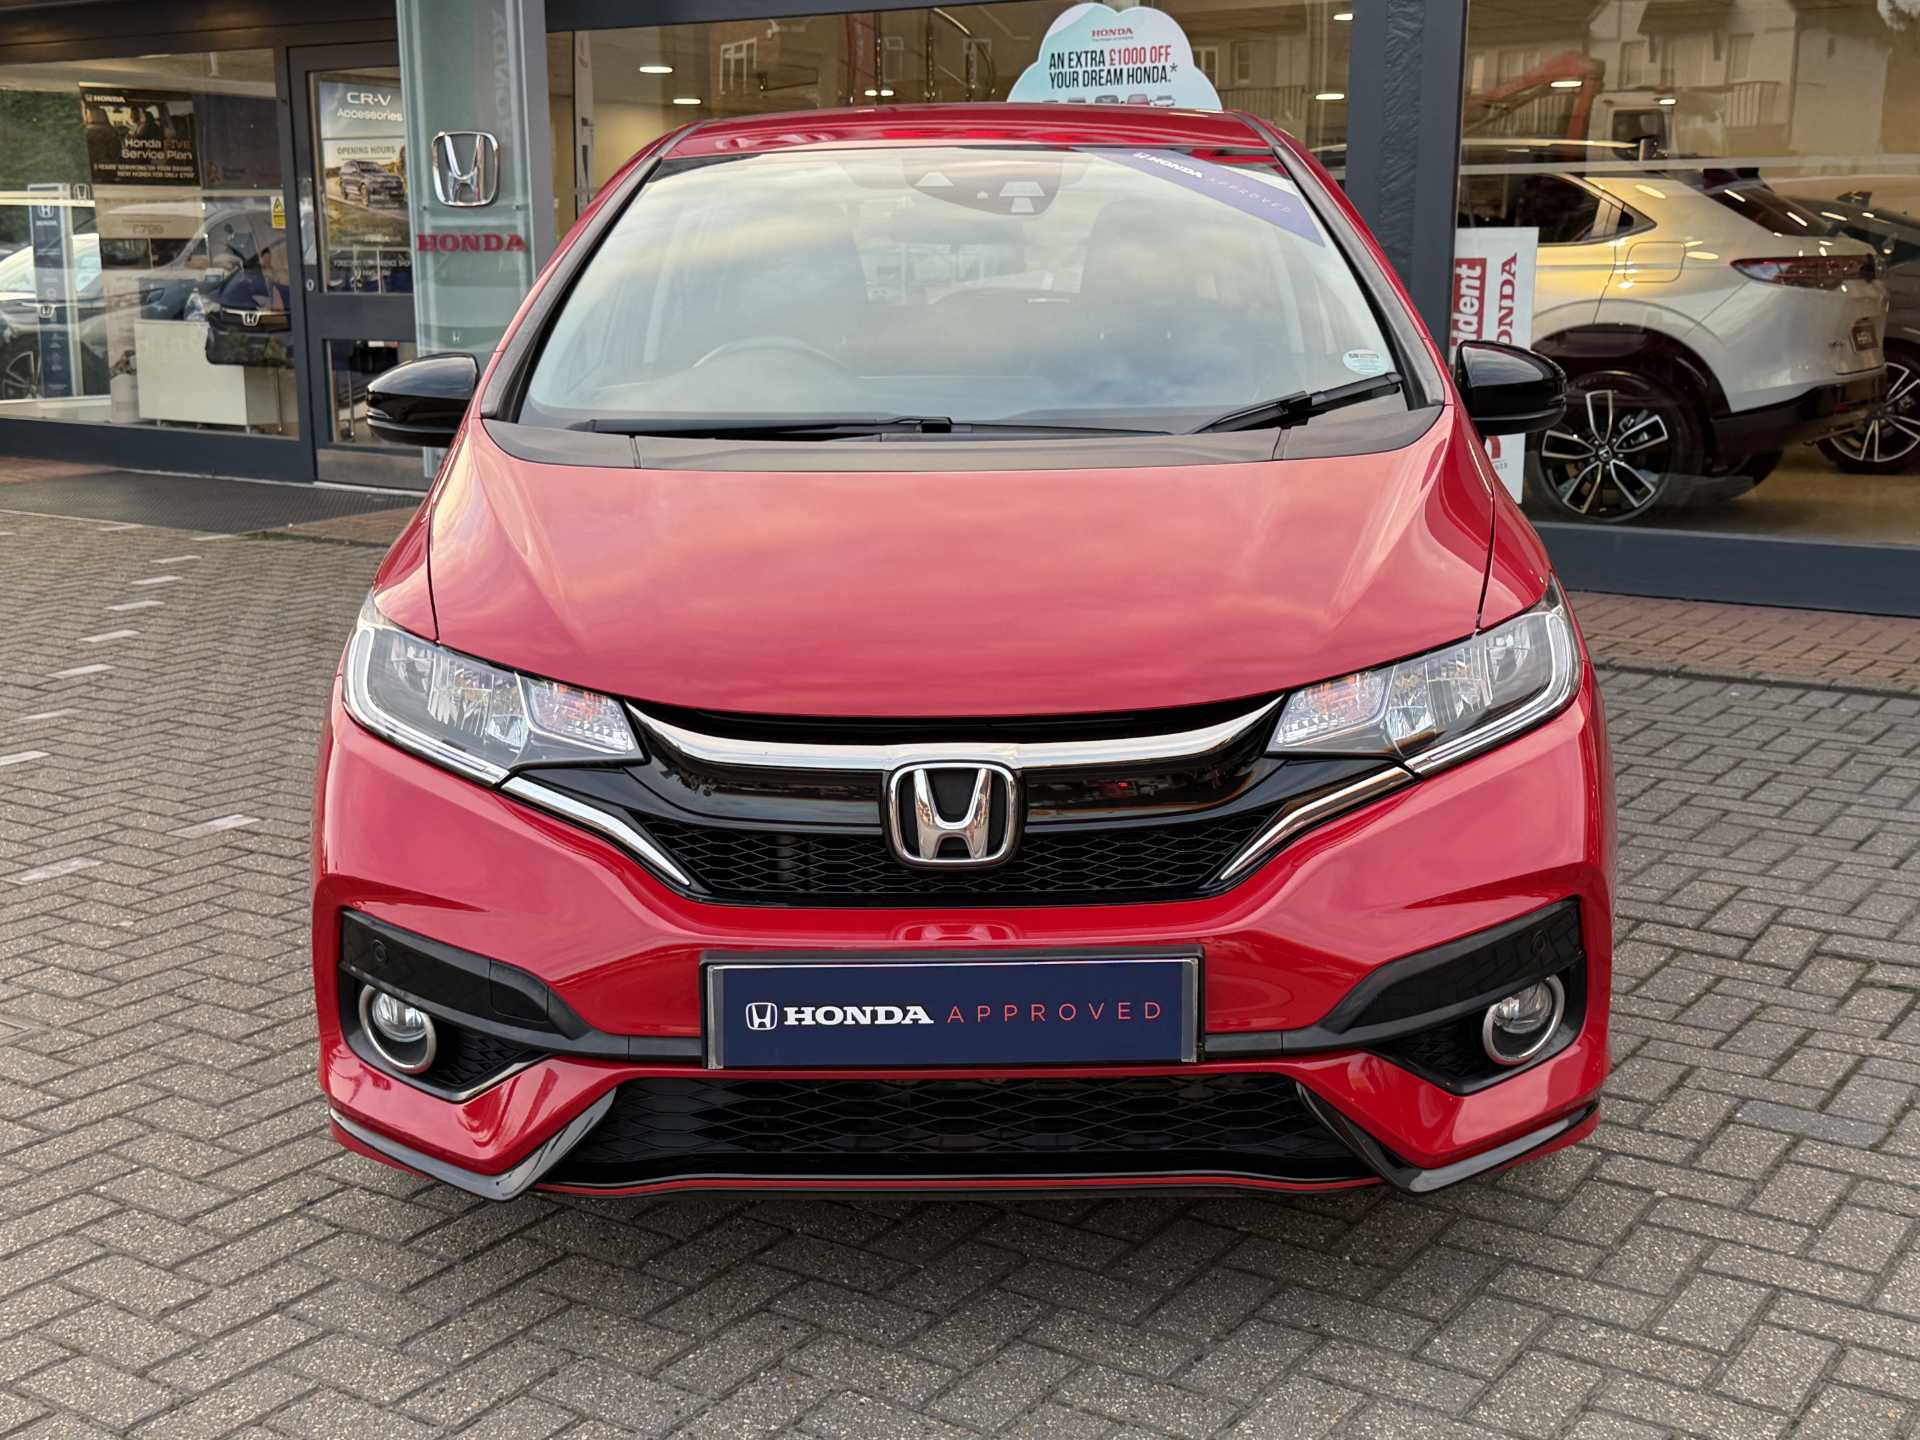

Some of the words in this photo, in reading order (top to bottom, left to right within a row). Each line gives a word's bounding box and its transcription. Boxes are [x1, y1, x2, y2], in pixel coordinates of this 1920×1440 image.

[1092, 28, 1133, 37] HONDA
[1049, 52, 1065, 70] AN
[1068, 50, 1105, 69] EXTRA
[1109, 48, 1147, 66] £1000
[1150, 45, 1172, 63] OFF
[1049, 71, 1079, 89] YOUR
[1082, 68, 1124, 87] DREAM
[337, 107, 404, 122] Accessories
[124, 138, 162, 149] Honda
[121, 149, 164, 160] Service
[166, 151, 193, 160] Plan
[1147, 156, 1203, 178] HONDA
[416, 234, 528, 252] HONDA
[784, 1005, 934, 1025] HONDA
[947, 1002, 1161, 1023] APPROVED
